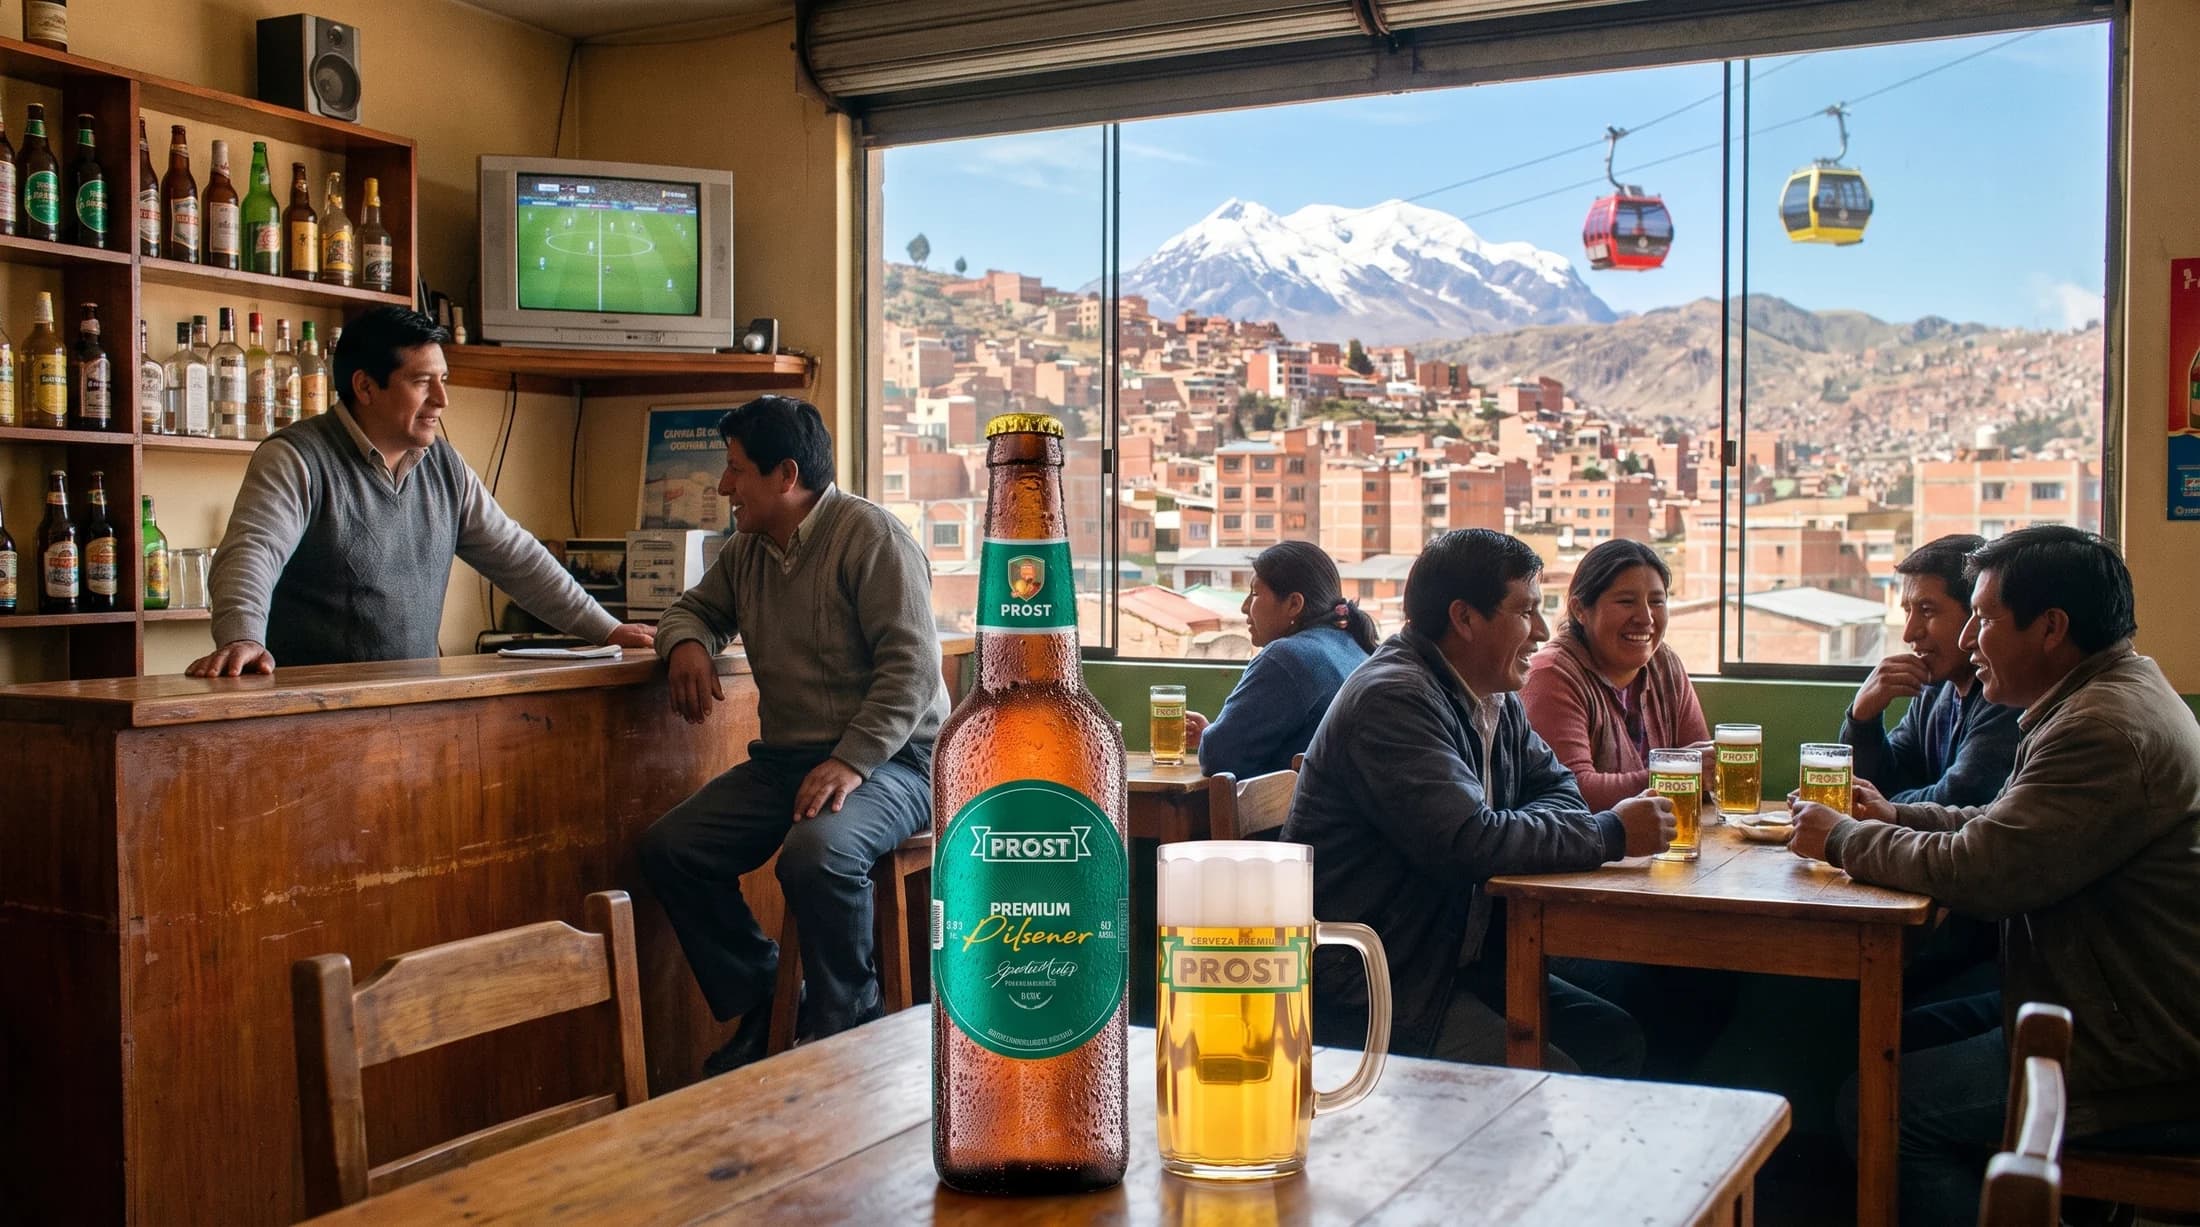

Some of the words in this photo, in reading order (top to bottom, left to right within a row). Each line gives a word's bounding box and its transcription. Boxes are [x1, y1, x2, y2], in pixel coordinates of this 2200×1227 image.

[1001, 604, 1052, 617] PROST
[1658, 781, 1693, 792] PROST
[991, 838, 1071, 858] PROST
[990, 902, 1071, 917] PREMIUM
[962, 914, 1094, 953] Pilsener
[1190, 937, 1234, 946] CERVEZA
[1180, 957, 1289, 985] PROST
